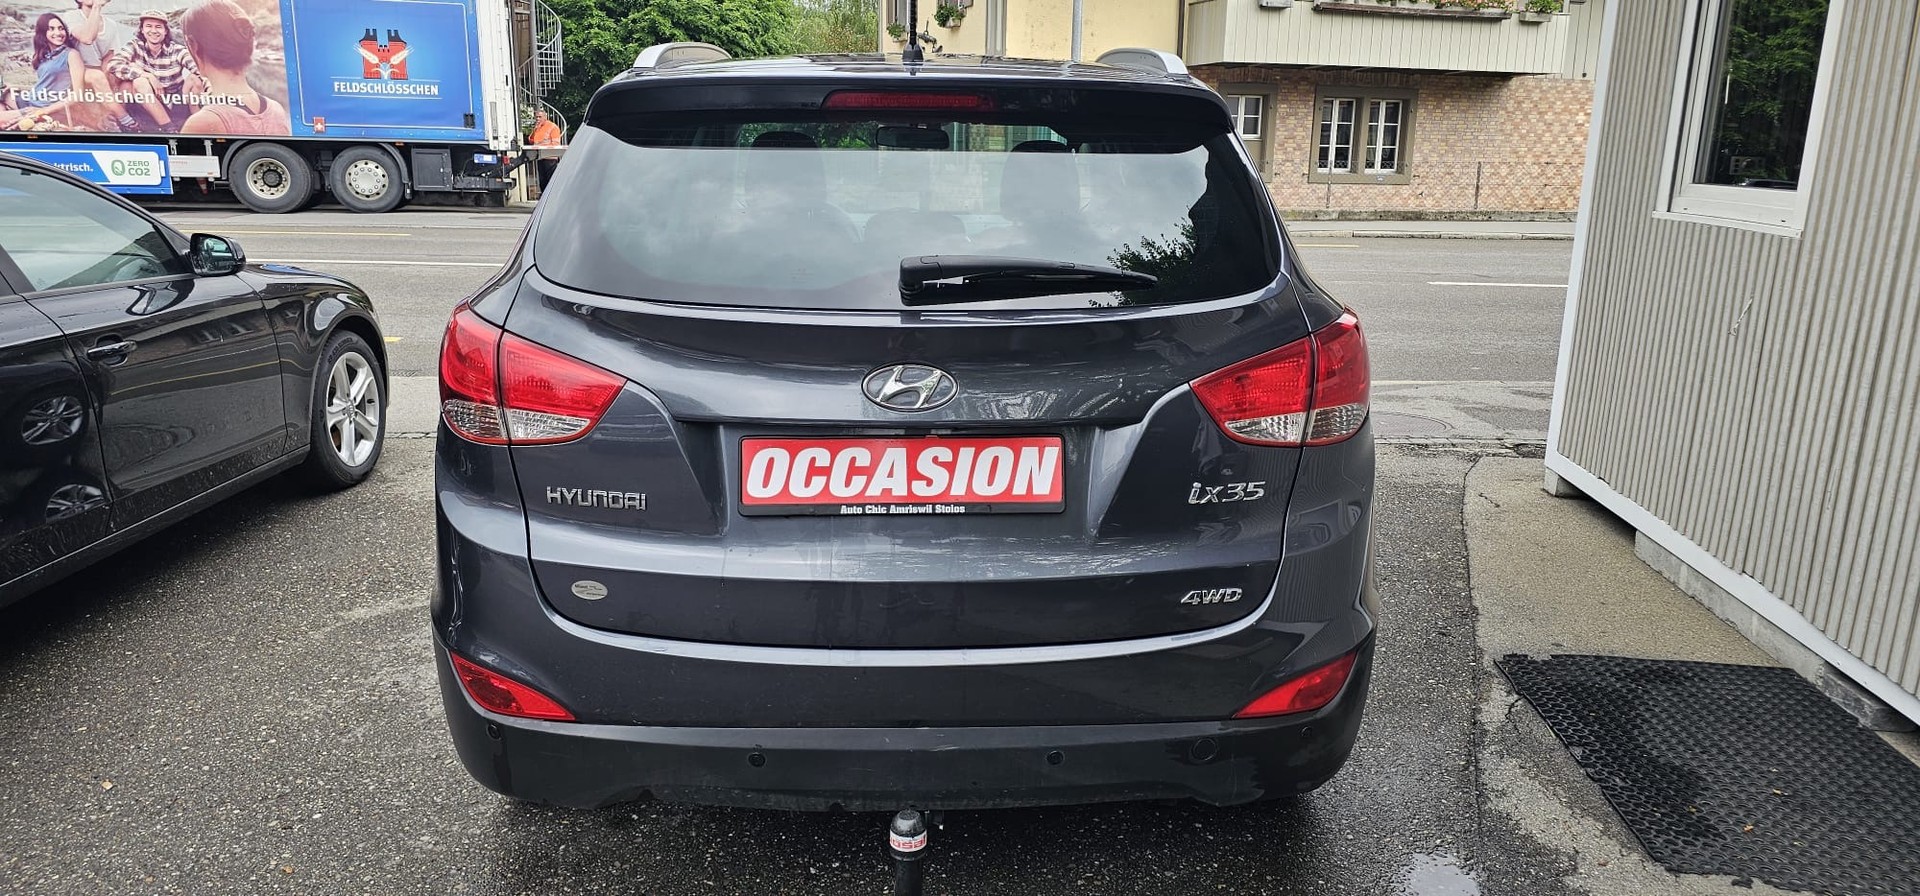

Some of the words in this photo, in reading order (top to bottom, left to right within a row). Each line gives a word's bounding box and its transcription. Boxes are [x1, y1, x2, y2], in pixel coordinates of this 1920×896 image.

[10, 87, 155, 105] Feldschlösschen
[161, 91, 245, 106] verbindet
[334, 81, 439, 95] FELDSCHLÖSSCHEN
[128, 167, 151, 176] CO2
[746, 446, 1060, 498] OCCASION
[546, 486, 646, 511] HYUNDAI
[1188, 481, 1266, 504] ix35
[840, 504, 863, 514] Auto
[865, 504, 887, 514] Chic
[889, 504, 933, 514] Amriswil
[1181, 588, 1242, 605] 4WD
